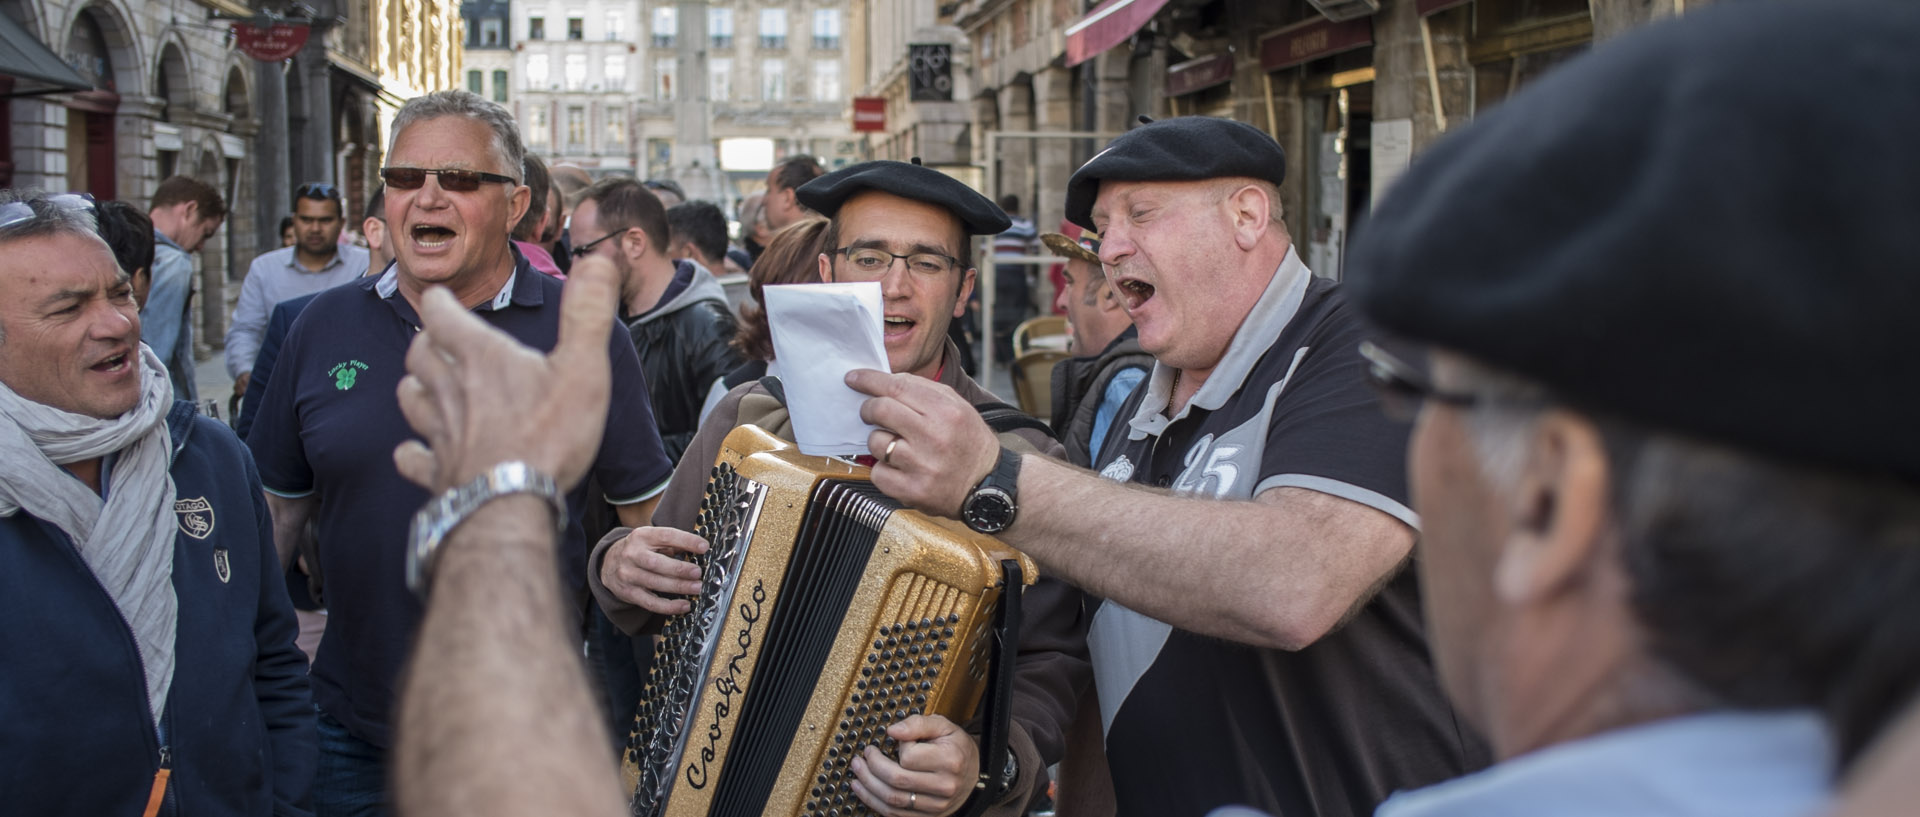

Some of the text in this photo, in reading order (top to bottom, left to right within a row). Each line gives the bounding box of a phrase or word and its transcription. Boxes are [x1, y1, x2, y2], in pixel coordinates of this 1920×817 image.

[1174, 433, 1243, 499] 25
[175, 502, 205, 510] OTAGO
[686, 579, 766, 790] Cavagnolo
